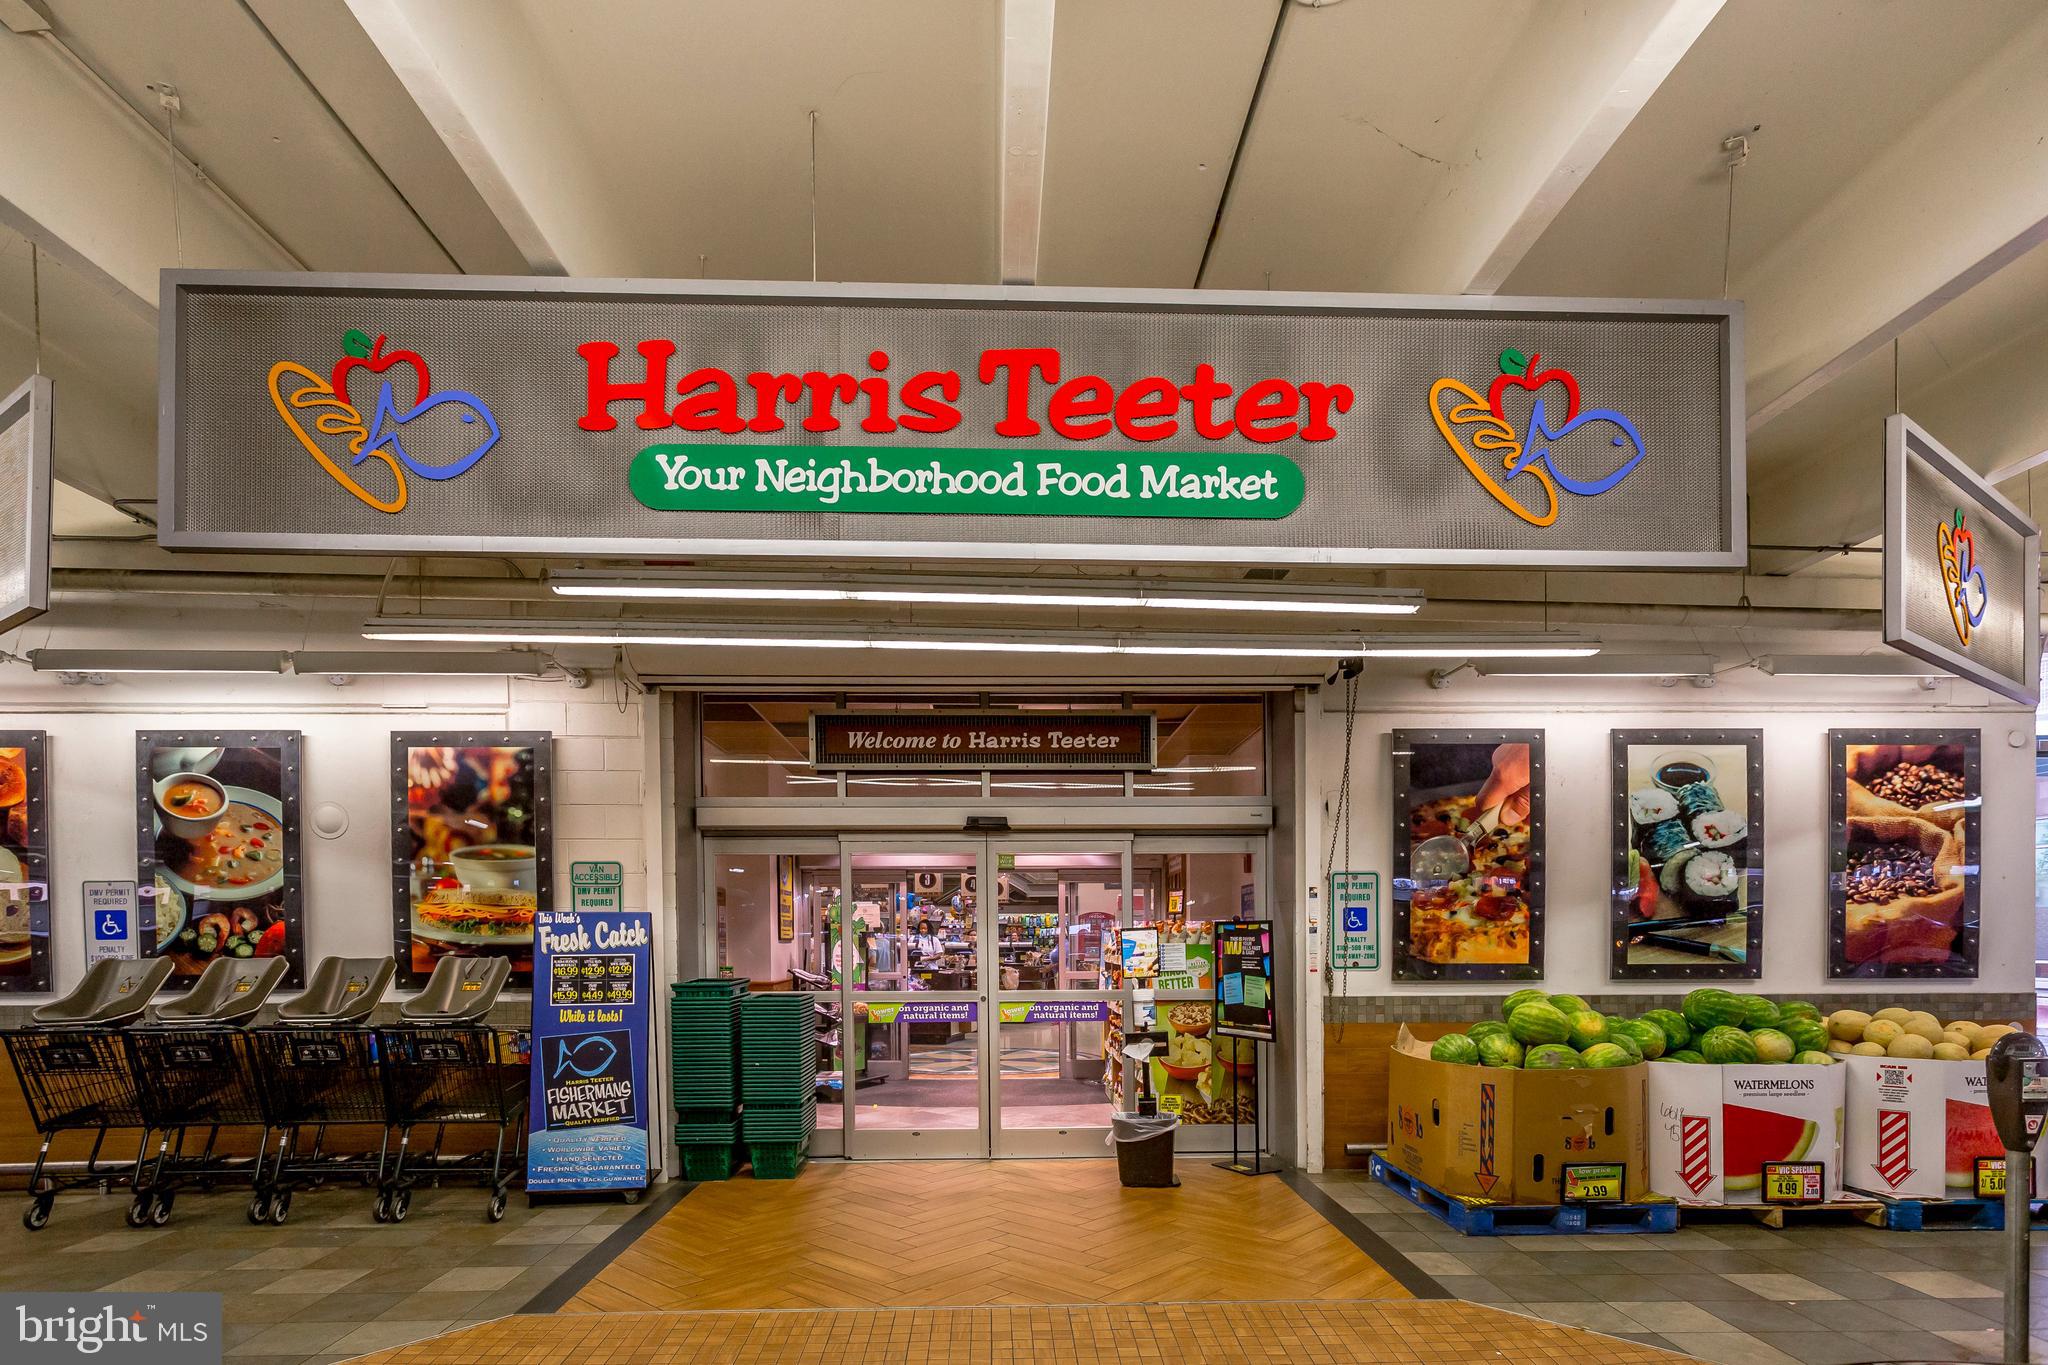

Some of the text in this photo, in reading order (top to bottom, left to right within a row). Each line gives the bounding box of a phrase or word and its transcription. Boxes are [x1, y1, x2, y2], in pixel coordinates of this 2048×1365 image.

[577, 339, 1355, 443] Harris Teeter
[655, 454, 1279, 505] Your Neighborhood Food Market
[847, 731, 1120, 749] Welcome to Harris Teeter
[589, 865, 604, 873] VAN
[574, 873, 618, 881] ACCESSIBLE
[924, 874, 931, 886] 3
[577, 887, 616, 895] DMV PERMIT
[1352, 882, 1373, 890] PERMIT
[89, 888, 130, 897] DMV PERMIT
[94, 897, 128, 905] REQUIRED
[581, 899, 613, 907] REQUIRED
[538, 912, 580, 924] This Week's
[538, 919, 648, 954] Fresh Catch
[98, 945, 125, 953] PENALTY
[553, 966, 579, 976] $16.99
[581, 966, 605, 976] $12.99
[608, 965, 632, 975] $12.99
[913, 1004, 947, 1013] organic
[1043, 1004, 1079, 1013] organic
[1081, 1003, 1099, 1011] and
[560, 1008, 623, 1023] While it lasts!
[903, 1012, 937, 1020] natural
[1034, 1011, 1098, 1019] natural items!
[566, 1076, 614, 1086] HARRIS TEETER
[1733, 1079, 1815, 1090] WATERMELONS
[547, 1080, 632, 1105] FISHERMANS
[552, 1097, 629, 1120] MARKET
[564, 1115, 620, 1126] QUALITY VERIFIED
[1779, 1165, 1790, 1174] VIC
[1583, 1185, 1608, 1197] 2.99
[1777, 1182, 1797, 1195] 4.99
